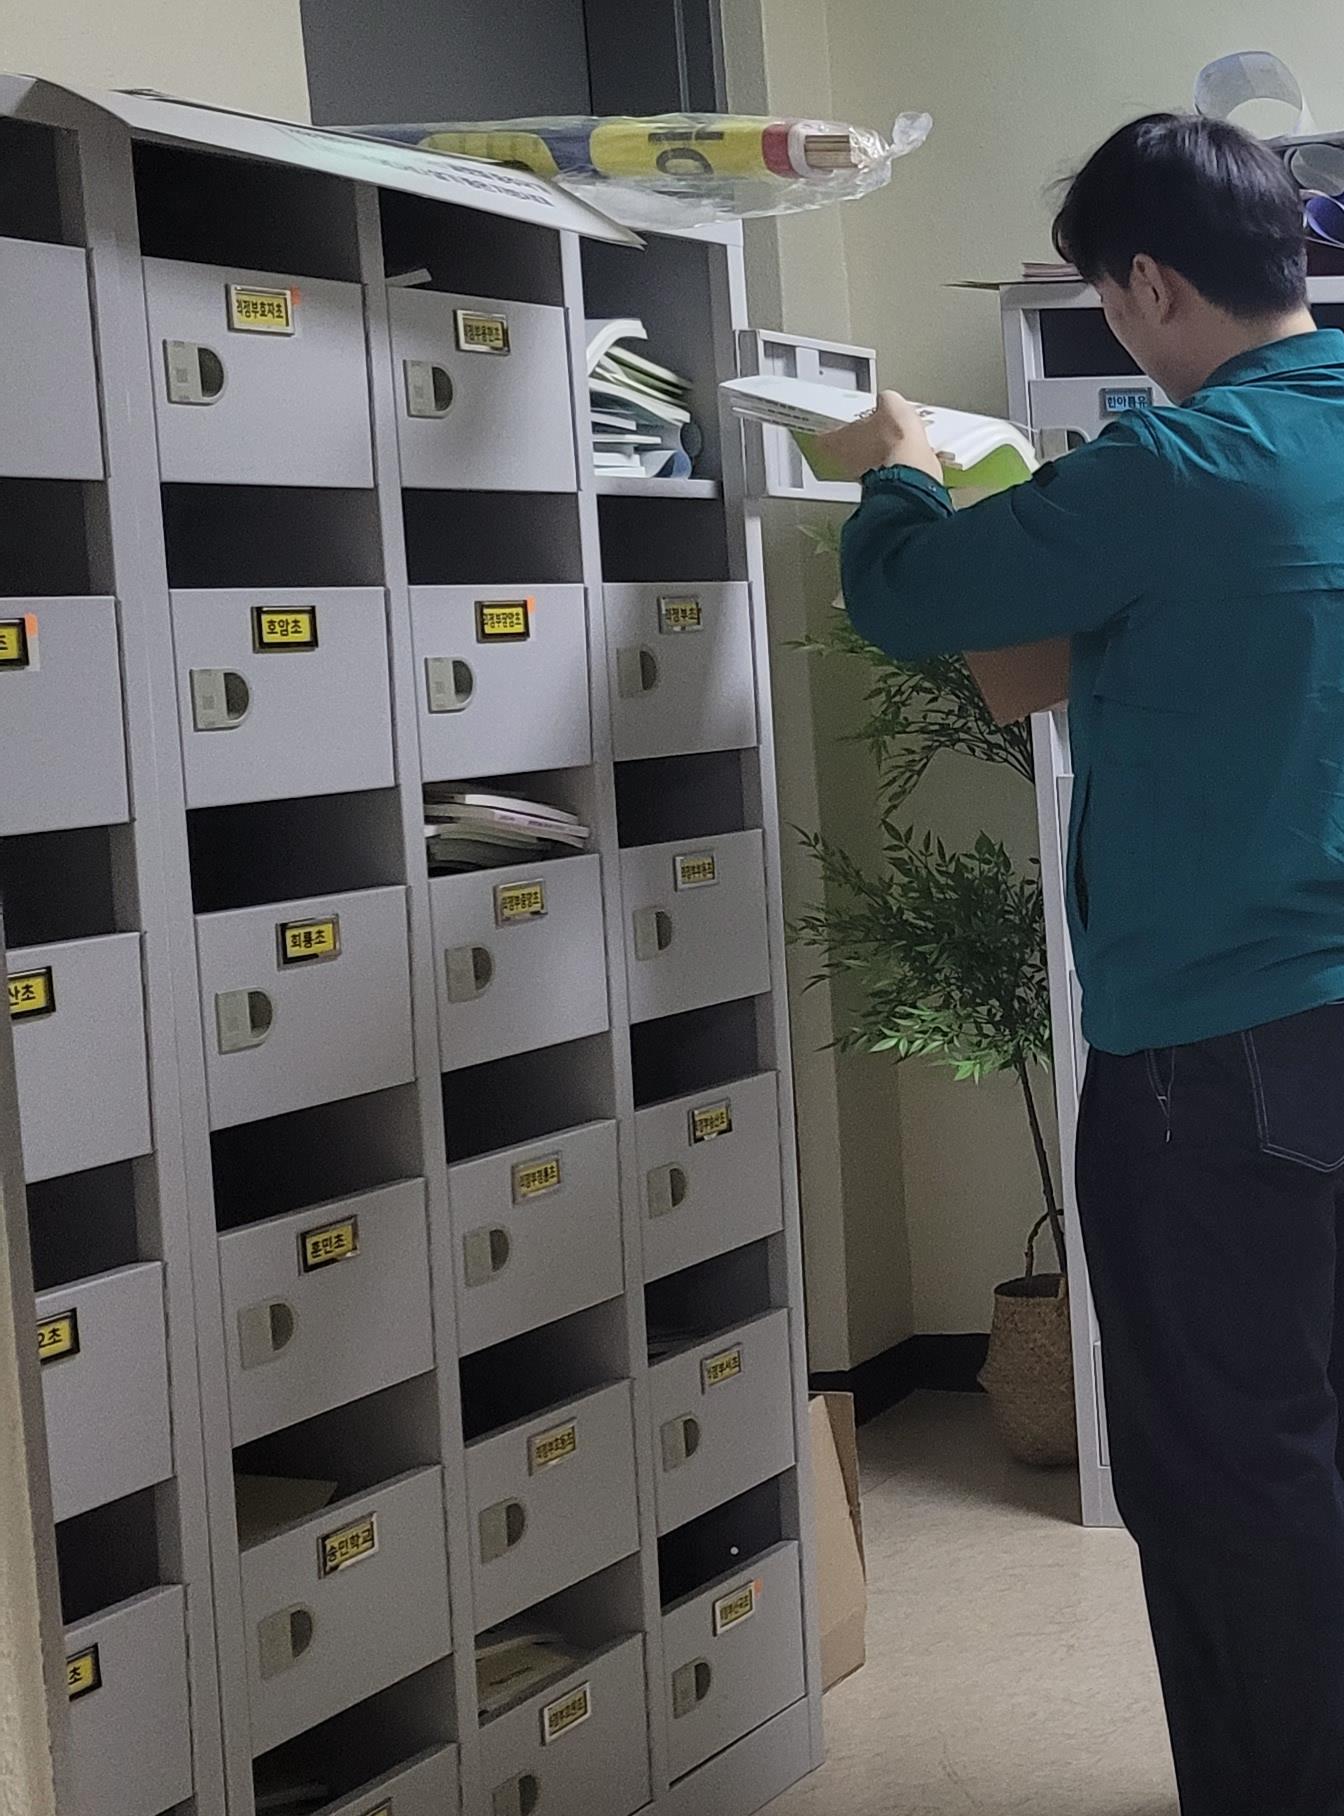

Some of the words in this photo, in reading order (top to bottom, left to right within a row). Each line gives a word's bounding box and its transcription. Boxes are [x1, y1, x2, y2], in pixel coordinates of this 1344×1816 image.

[266, 618, 302, 637] 호암초
[290, 930, 326, 949] 회룡초
[310, 1233, 346, 1259] 훈민초
[327, 1527, 373, 1562] 송민학교
